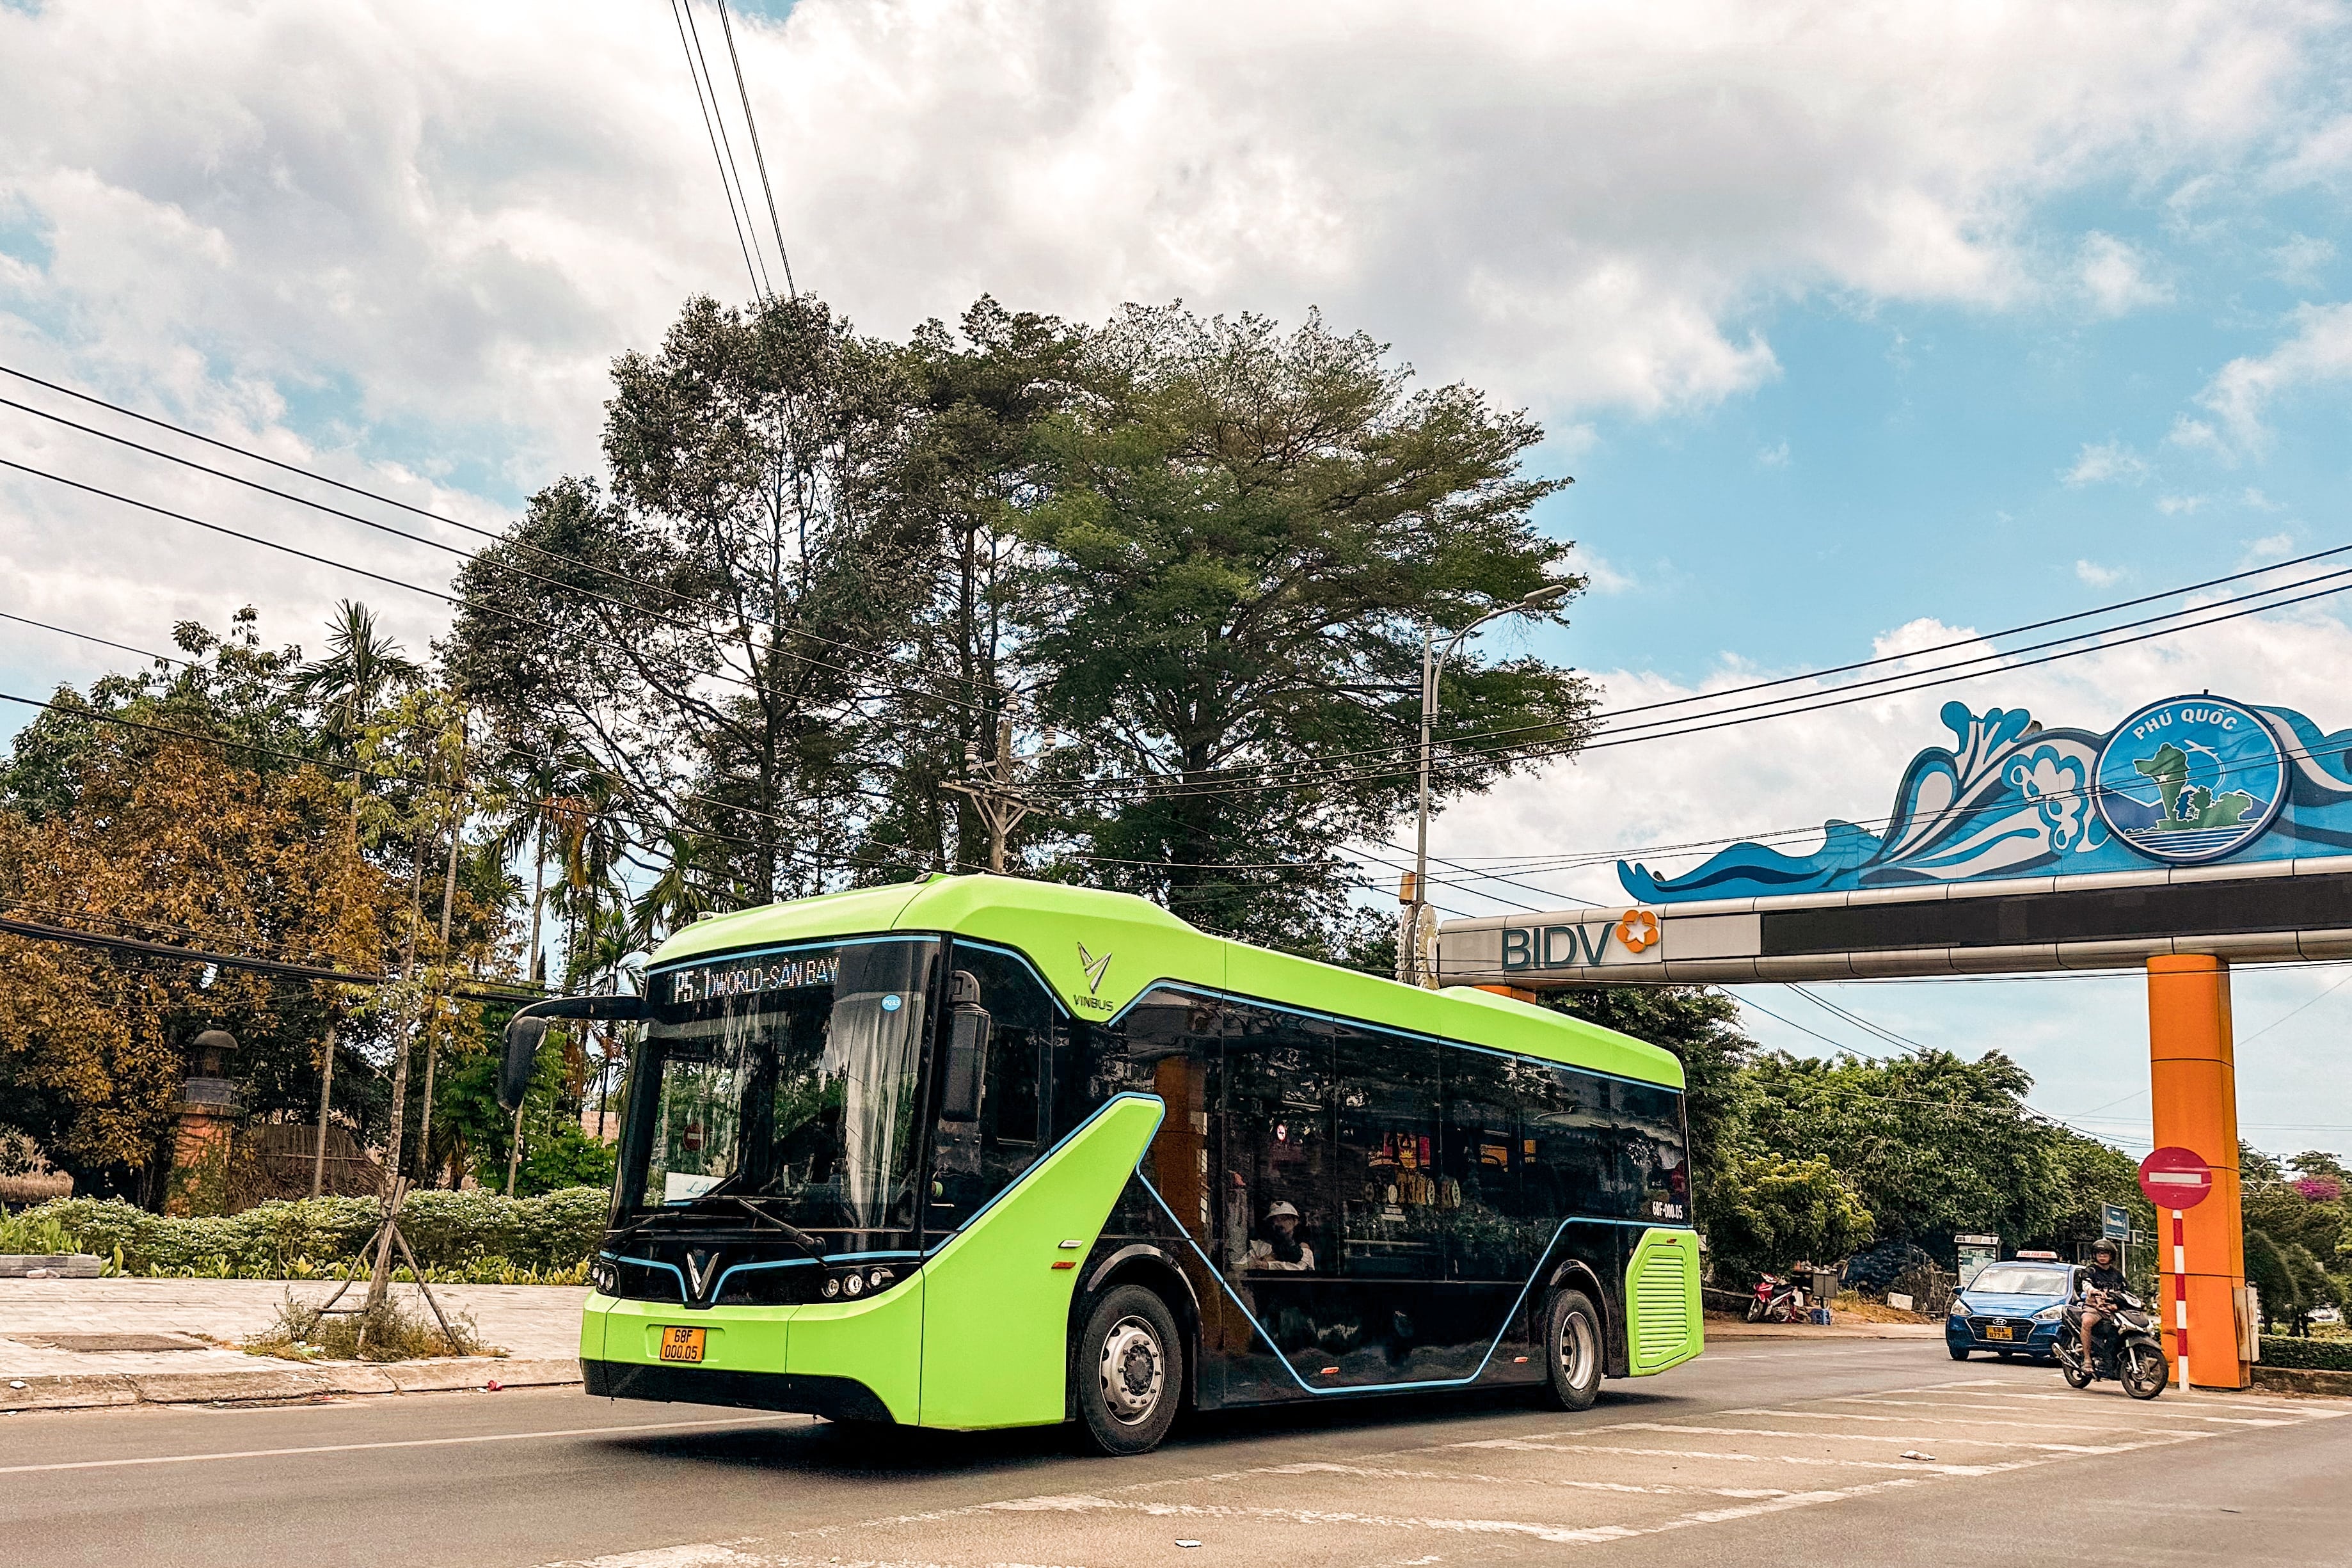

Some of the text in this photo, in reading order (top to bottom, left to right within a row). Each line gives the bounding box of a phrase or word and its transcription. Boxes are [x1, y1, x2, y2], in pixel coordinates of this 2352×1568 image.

[2133, 708, 2237, 740] PHÚ QUỐC
[1502, 923, 1616, 970] BIDV
[805, 956, 839, 985] BAY
[1073, 994, 1114, 1011] VINBUS
[1652, 1201, 1683, 1219] 68F-000.05
[674, 1329, 694, 1343] 68F
[664, 1344, 698, 1359] 000.05
